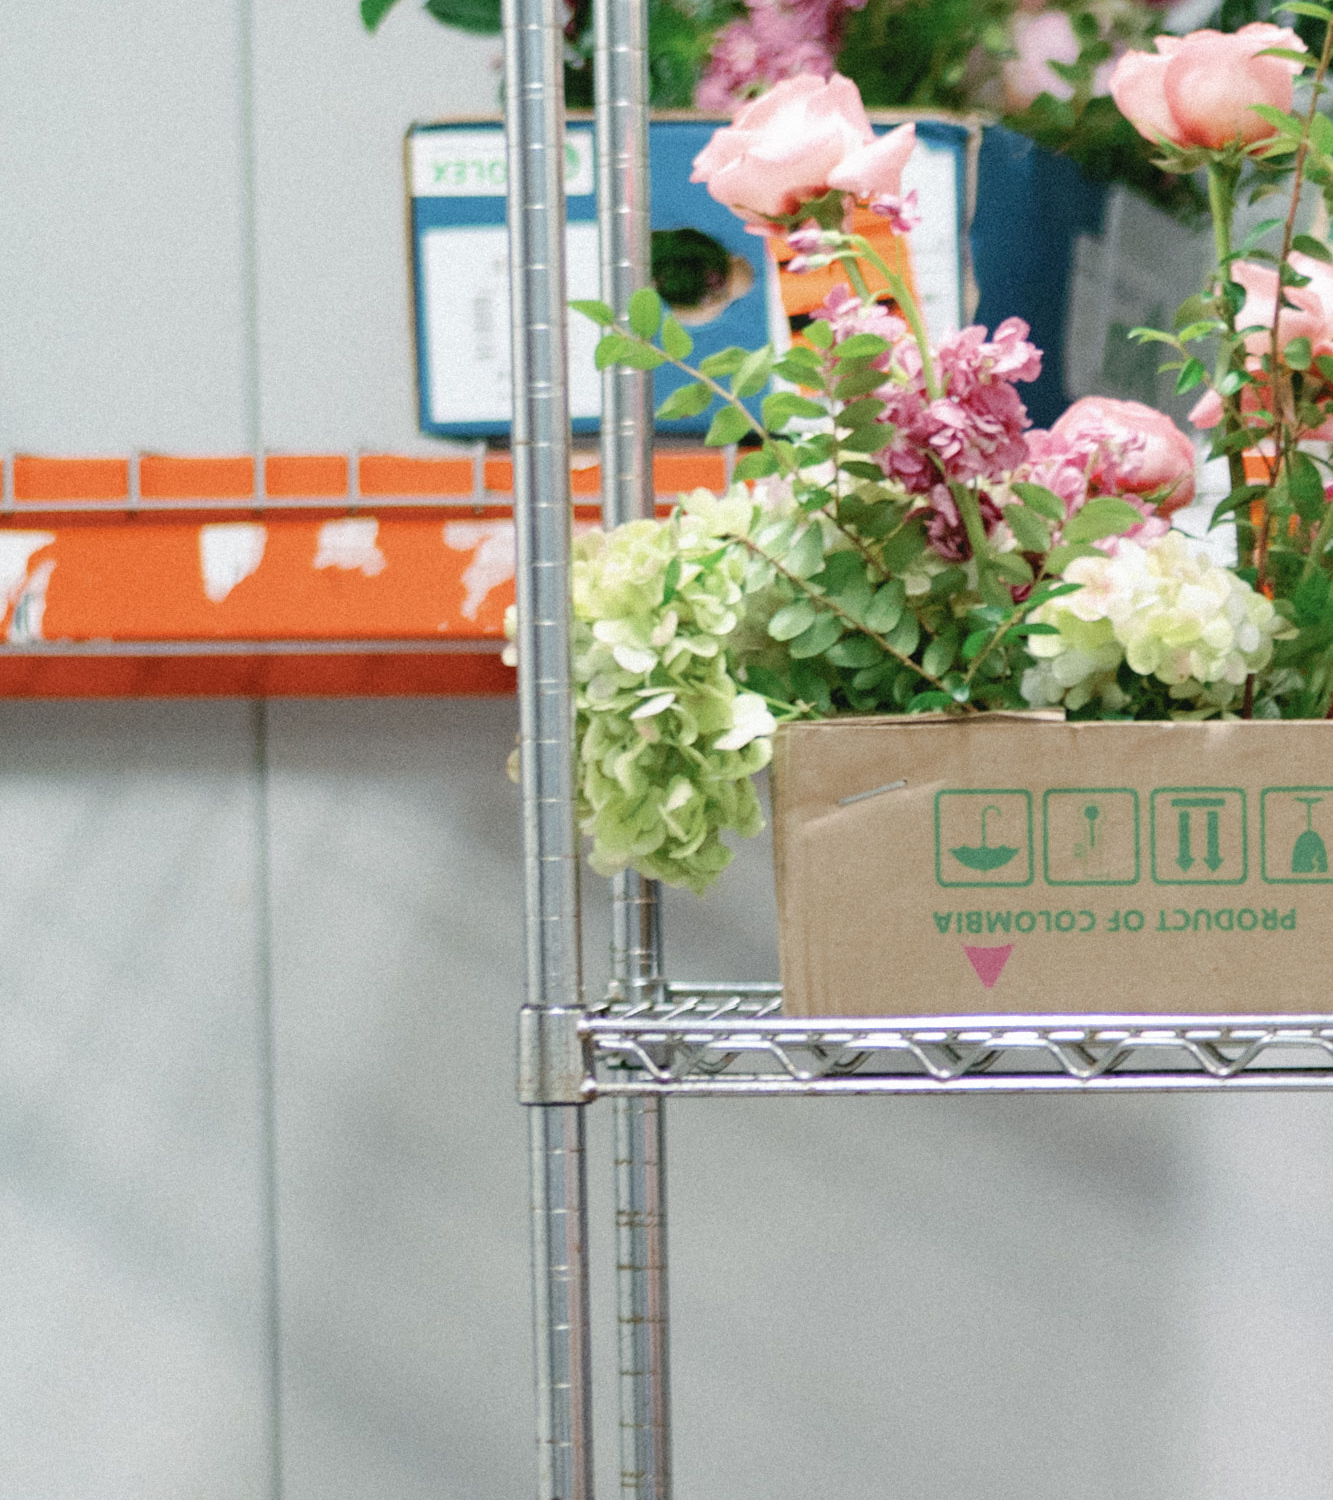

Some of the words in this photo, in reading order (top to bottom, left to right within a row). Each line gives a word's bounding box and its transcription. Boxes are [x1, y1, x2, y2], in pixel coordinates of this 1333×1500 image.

[431, 158, 508, 185] OLEX
[932, 910, 1097, 935] COLOMBIA
[1107, 908, 1146, 932] OF
[1156, 905, 1298, 933] PRODUCT
